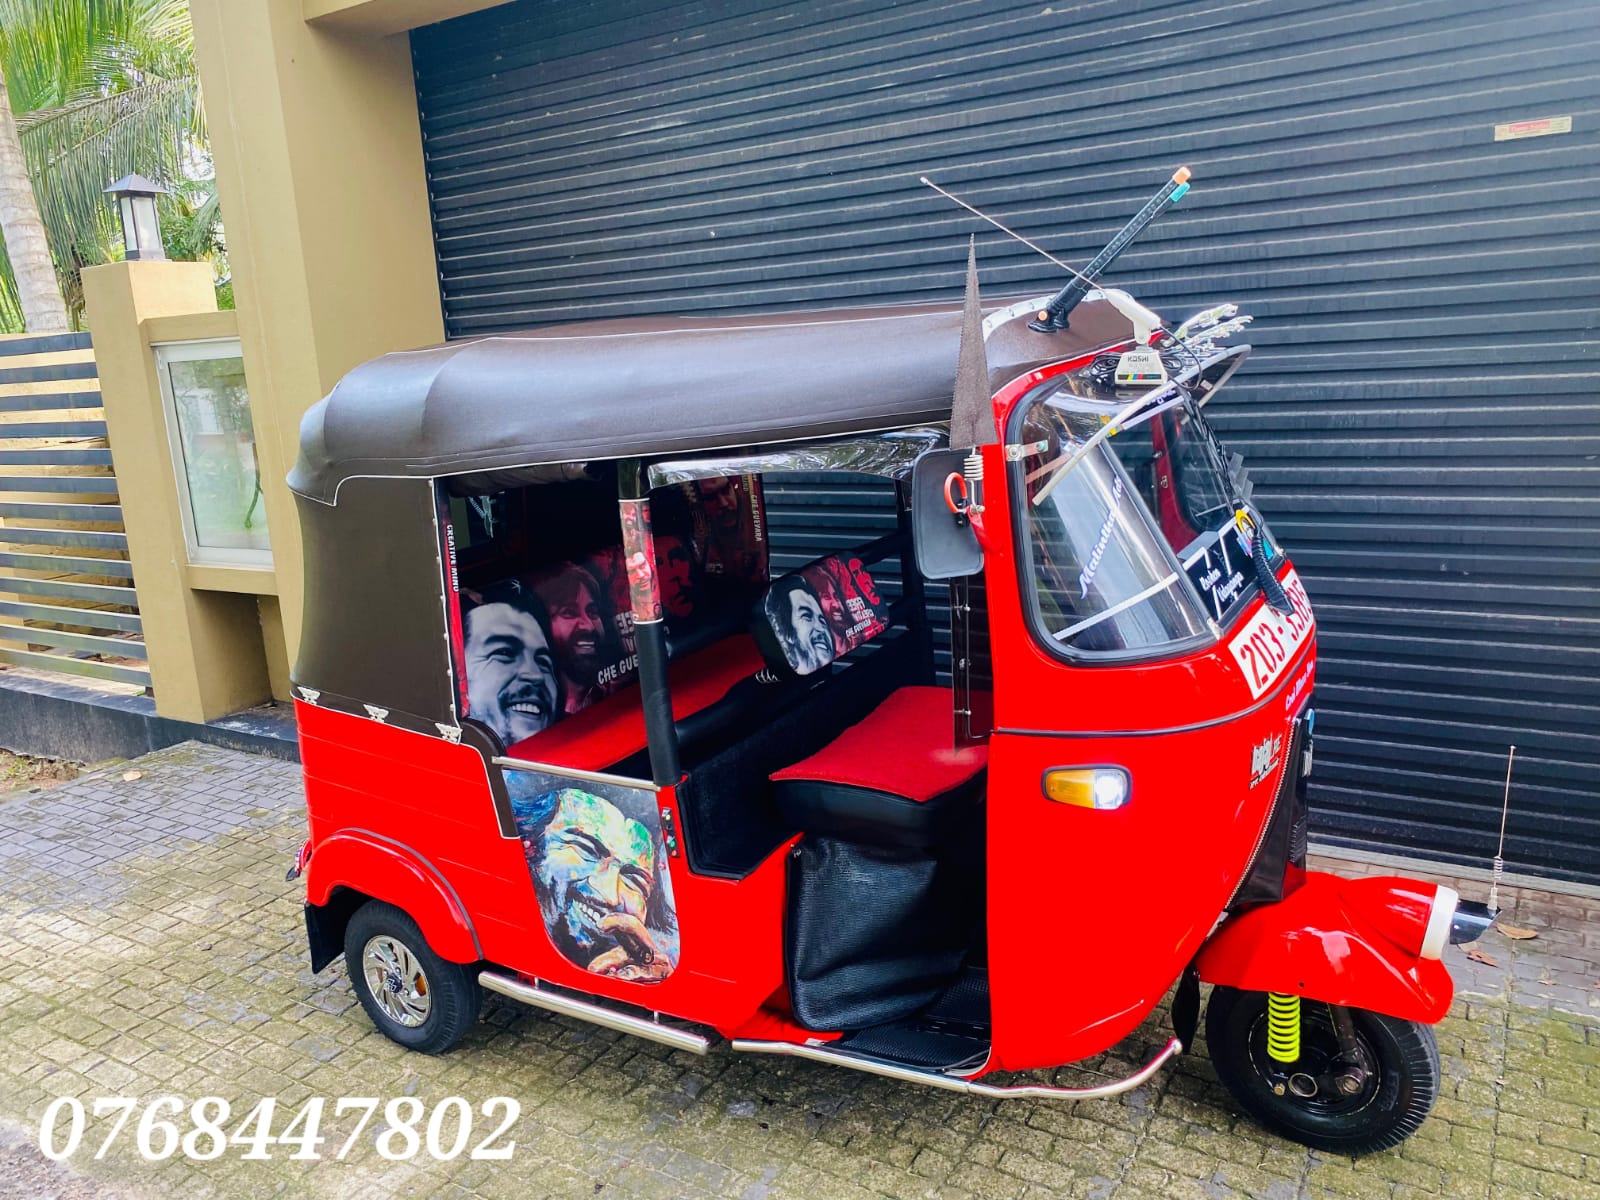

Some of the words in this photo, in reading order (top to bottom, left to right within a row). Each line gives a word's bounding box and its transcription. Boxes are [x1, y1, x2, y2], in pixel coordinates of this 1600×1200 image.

[446, 524, 457, 566] CREATIVE
[598, 664, 617, 685] CHE
[619, 654, 640, 675] GUE
